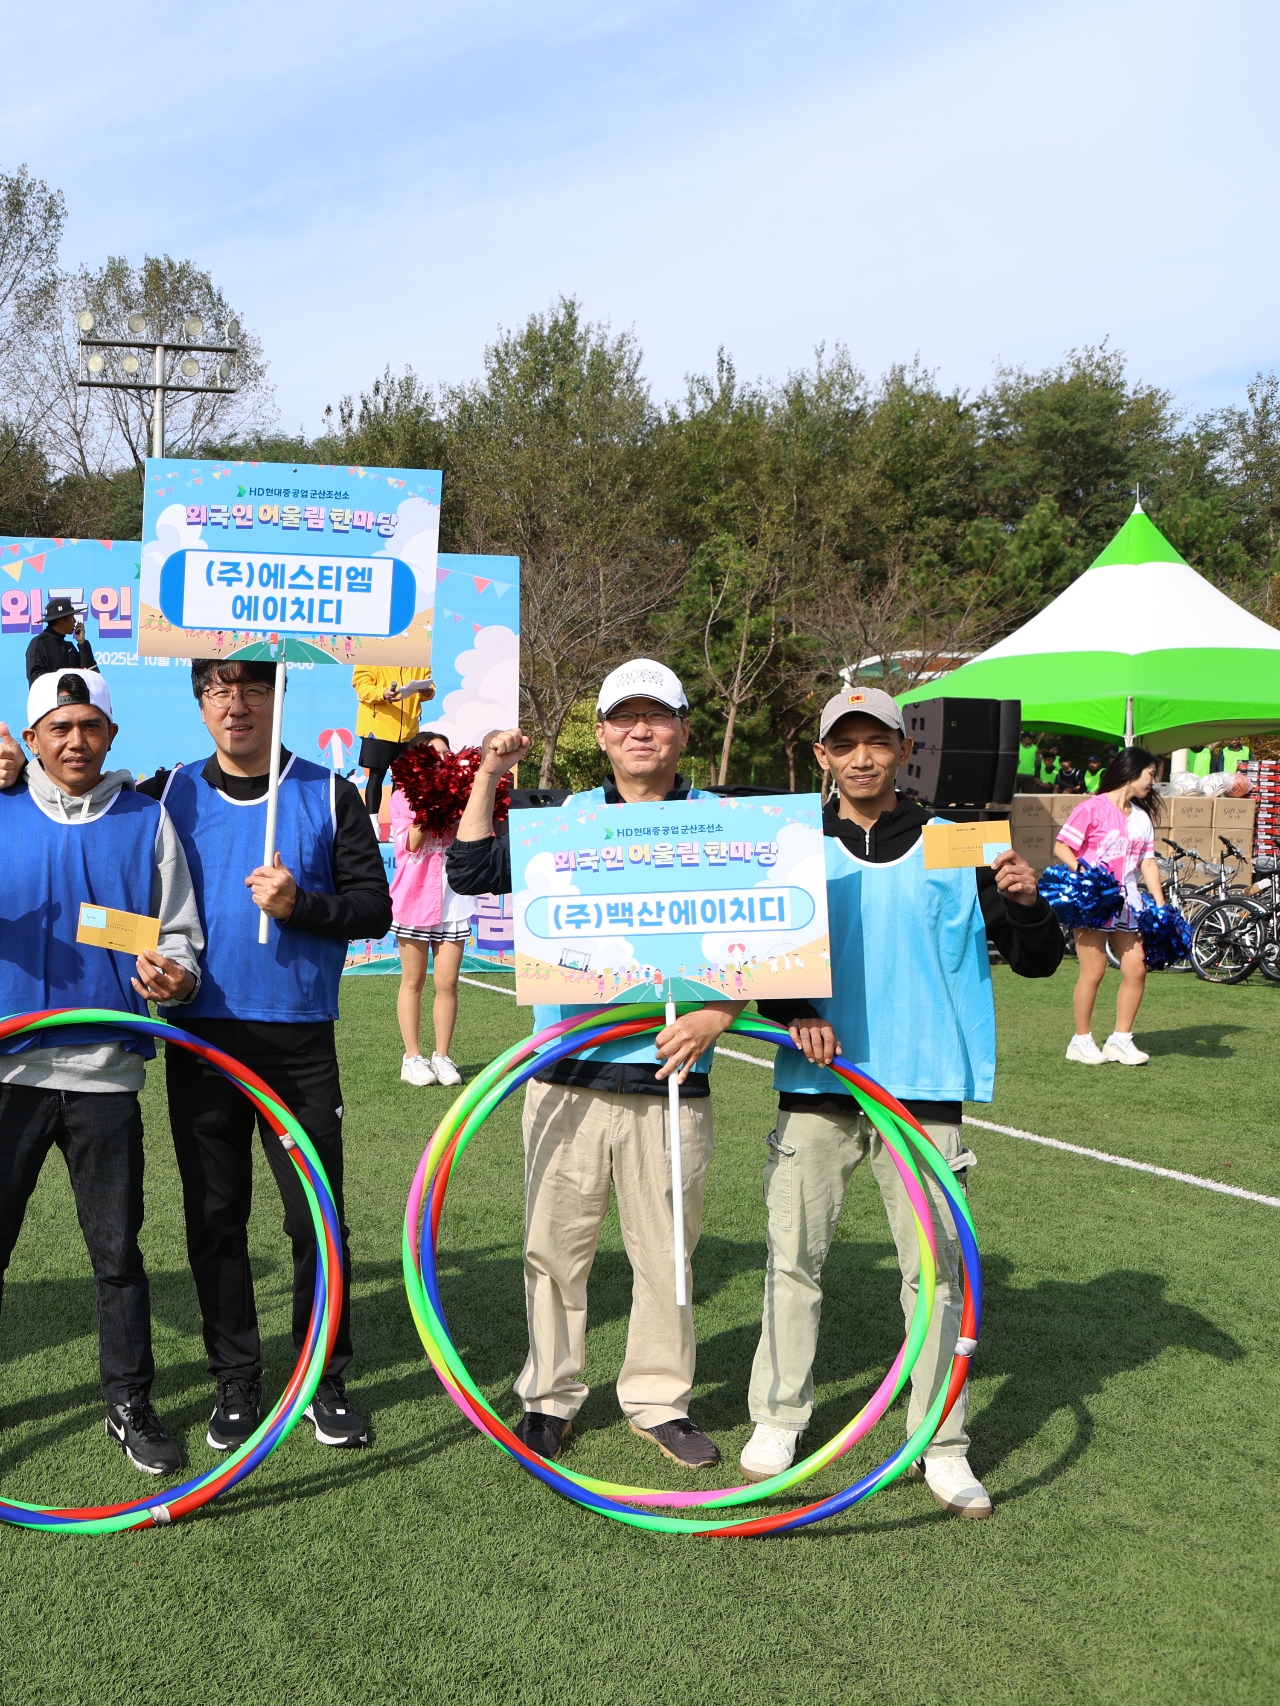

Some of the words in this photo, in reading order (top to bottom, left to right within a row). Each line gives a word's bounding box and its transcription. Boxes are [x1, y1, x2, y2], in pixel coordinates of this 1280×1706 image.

[249, 486, 308, 499] HD현대중공업
[309, 490, 350, 500] 군산조선소
[185, 504, 254, 530] 외국인
[257, 504, 326, 534] 어울림
[329, 508, 400, 538] 한마당
[205, 560, 373, 594] (주)에스티엠
[231, 595, 343, 625] 에이치디
[94, 651, 138, 666] 2025년
[1181, 807, 1193, 815] Gift
[1223, 807, 1236, 816] Gift
[616, 825, 679, 838] HD현대중공업
[680, 823, 724, 835] 군산조선소
[553, 845, 625, 873] 외국인
[628, 841, 700, 867] 어울림
[703, 841, 780, 867] 한마당
[553, 896, 786, 930] (주)백산에이치디
